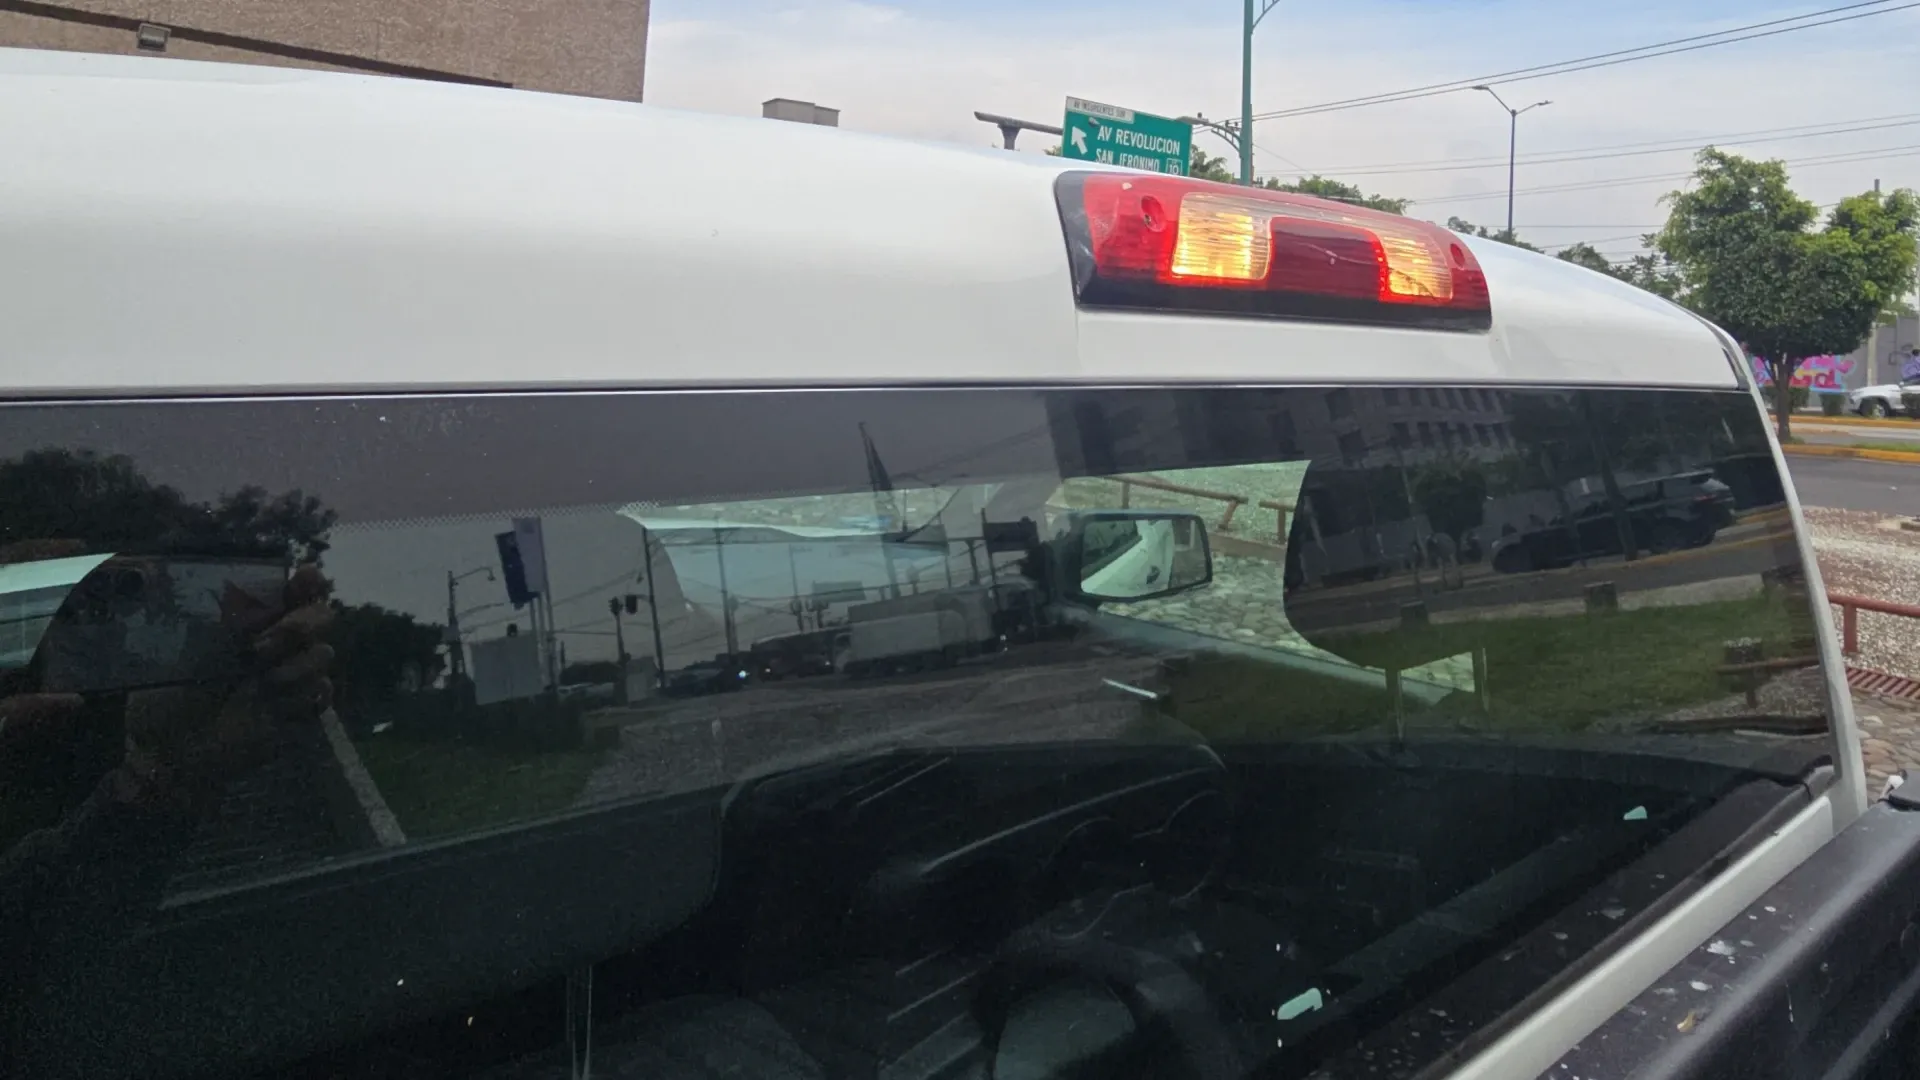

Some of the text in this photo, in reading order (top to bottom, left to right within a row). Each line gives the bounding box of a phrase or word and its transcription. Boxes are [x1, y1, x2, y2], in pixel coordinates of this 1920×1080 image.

[1097, 125, 1181, 155] AV REVOLUCION
[1096, 148, 1113, 165] SAN
